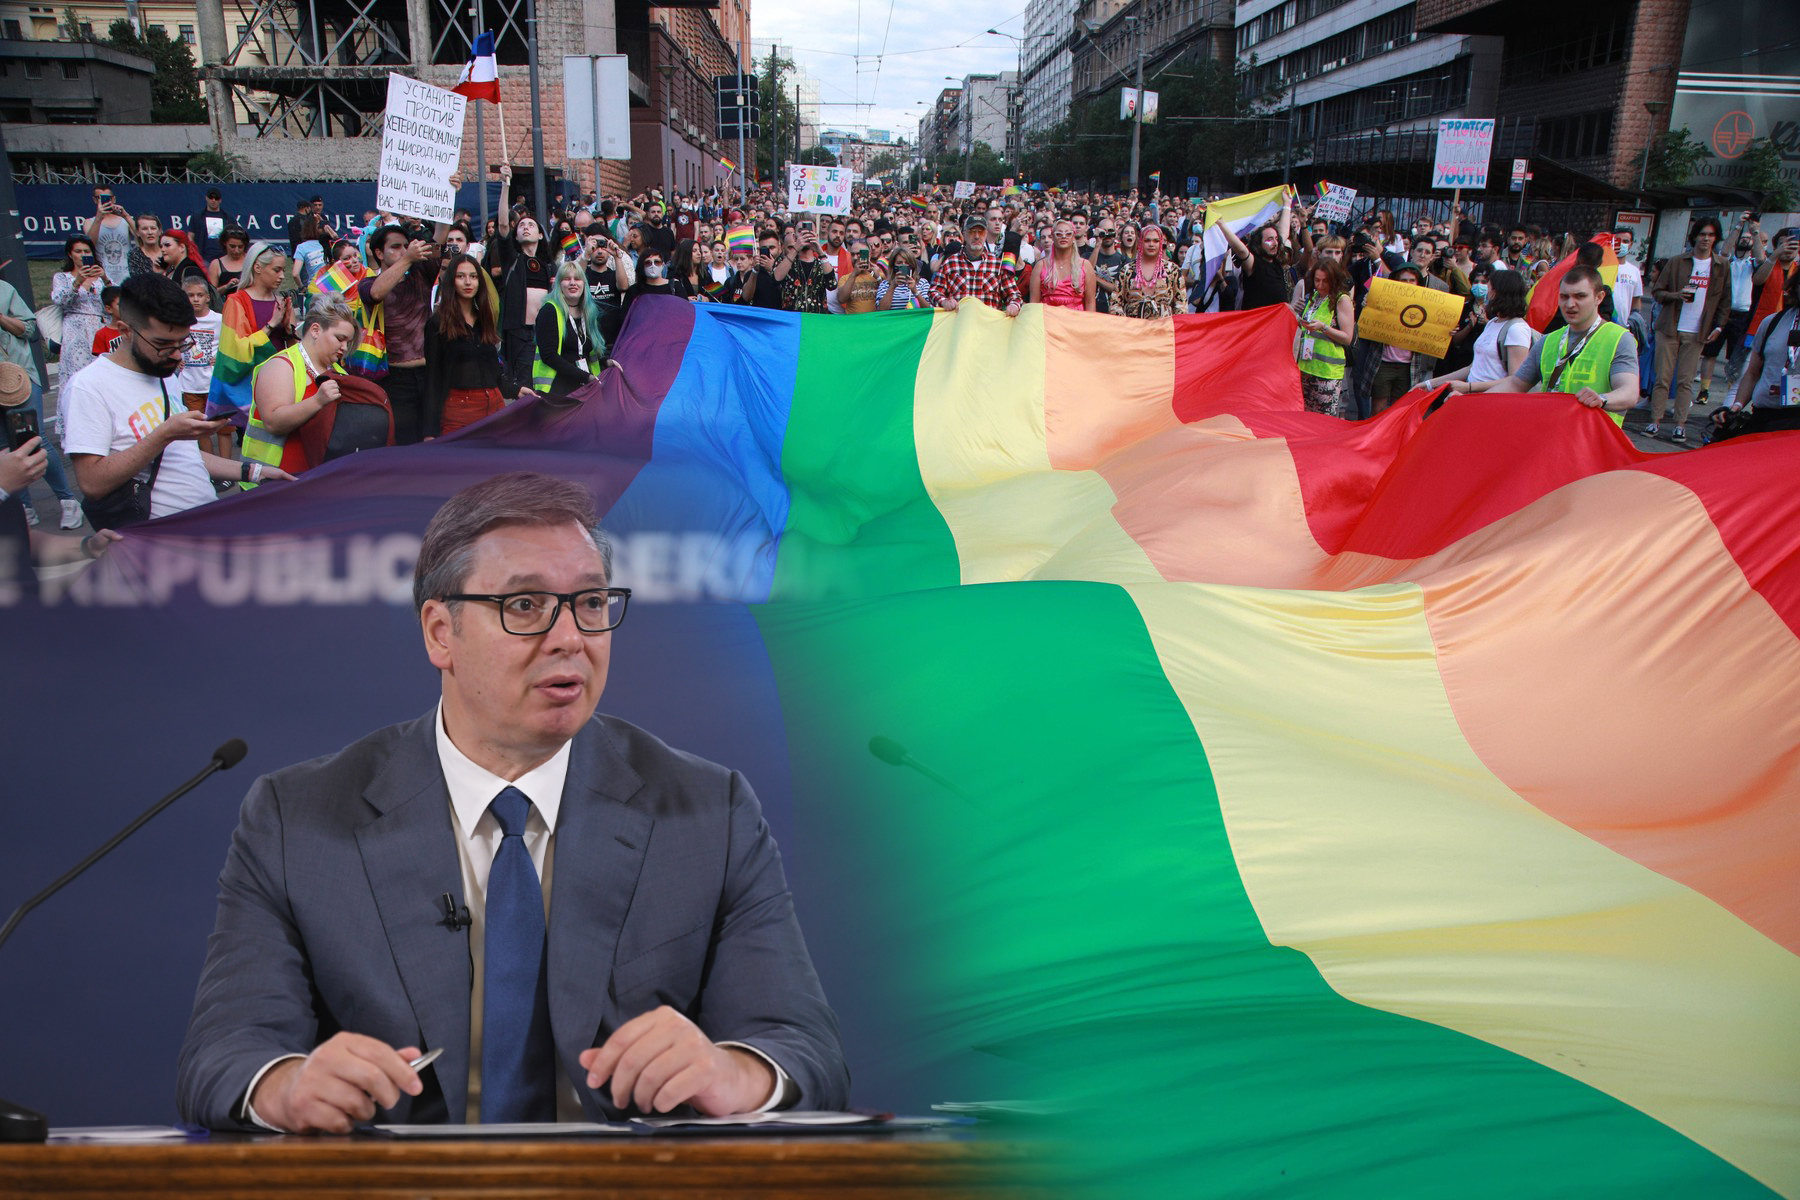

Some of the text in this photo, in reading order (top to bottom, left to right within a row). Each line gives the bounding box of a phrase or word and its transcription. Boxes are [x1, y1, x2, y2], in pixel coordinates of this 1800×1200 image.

[403, 80, 462, 112] УСТАНИТЕ
[405, 100, 455, 128] ПРОТИВ
[385, 136, 394, 151] И
[385, 155, 441, 182] ФАШИЗМА,
[800, 168, 840, 182] SVE JE
[1436, 163, 1486, 185] YOUTH
[381, 174, 449, 203] ВАША ТИШИНА
[812, 184, 826, 193] TO
[378, 194, 395, 209] ВАС
[797, 193, 843, 208] LJUBAV
[1421, 289, 1446, 305] RIGHTS
